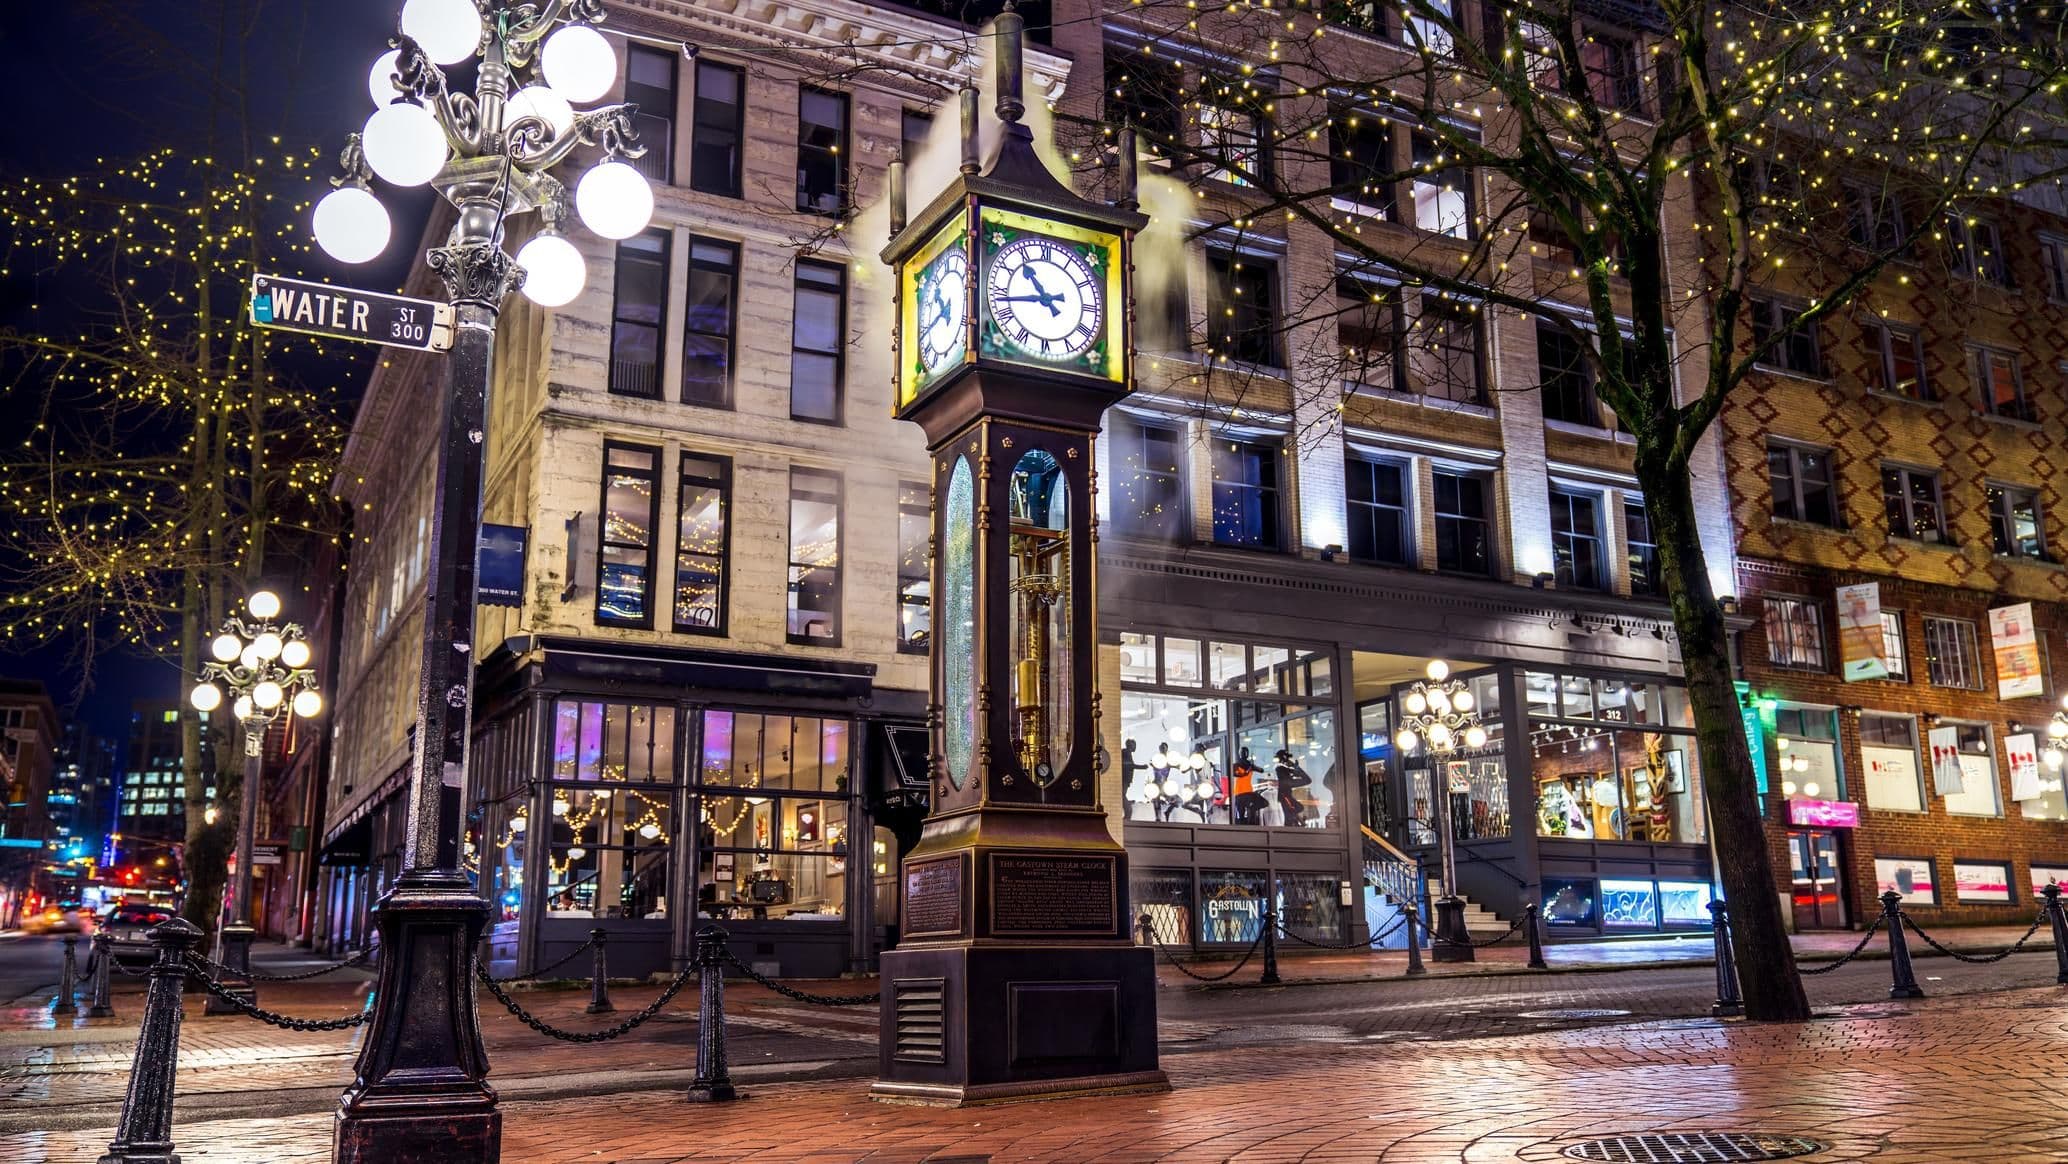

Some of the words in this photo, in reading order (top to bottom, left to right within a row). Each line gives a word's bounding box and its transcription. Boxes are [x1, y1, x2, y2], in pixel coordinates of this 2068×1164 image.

[271, 287, 370, 332] WATER
[399, 307, 416, 323] ST
[391, 324, 424, 341] 300
[1606, 710, 1621, 720] 312
[1208, 900, 1259, 919] GASTOWN
